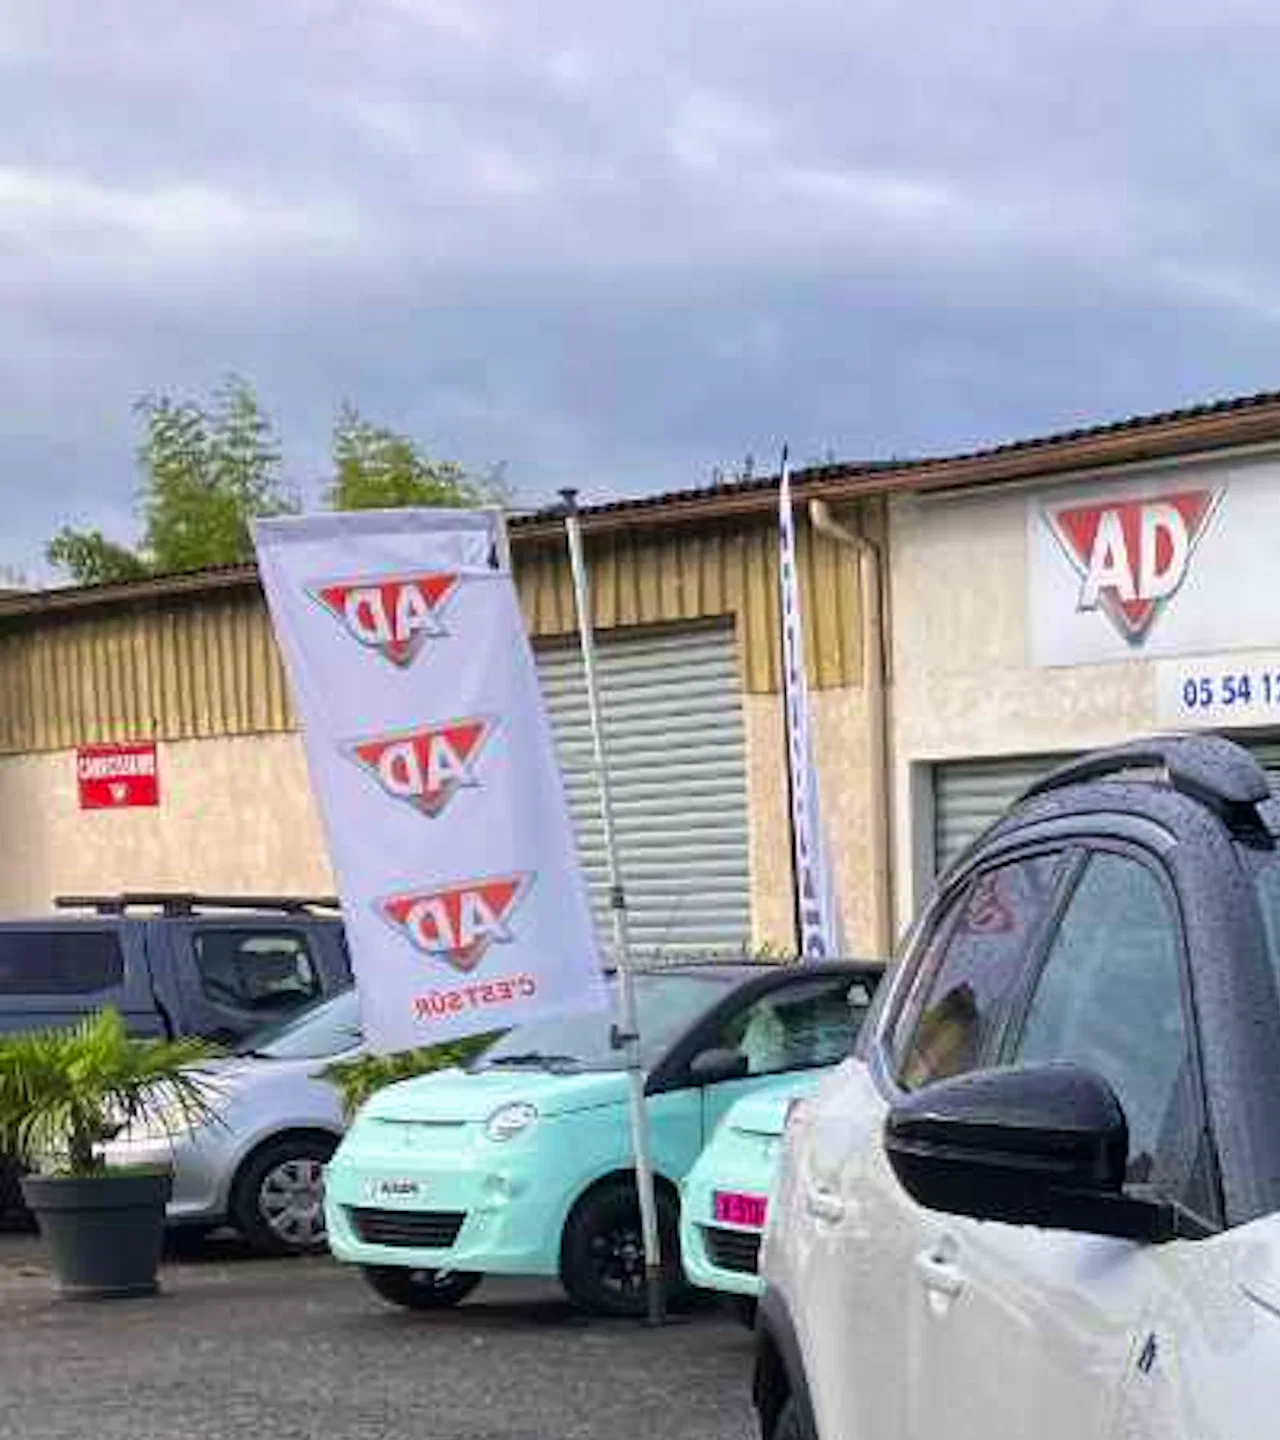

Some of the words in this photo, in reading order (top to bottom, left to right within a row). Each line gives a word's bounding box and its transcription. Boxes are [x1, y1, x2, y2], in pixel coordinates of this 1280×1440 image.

[1078, 503, 1190, 611] AD
[1183, 677, 1214, 708] 05
[1221, 674, 1251, 704] 54
